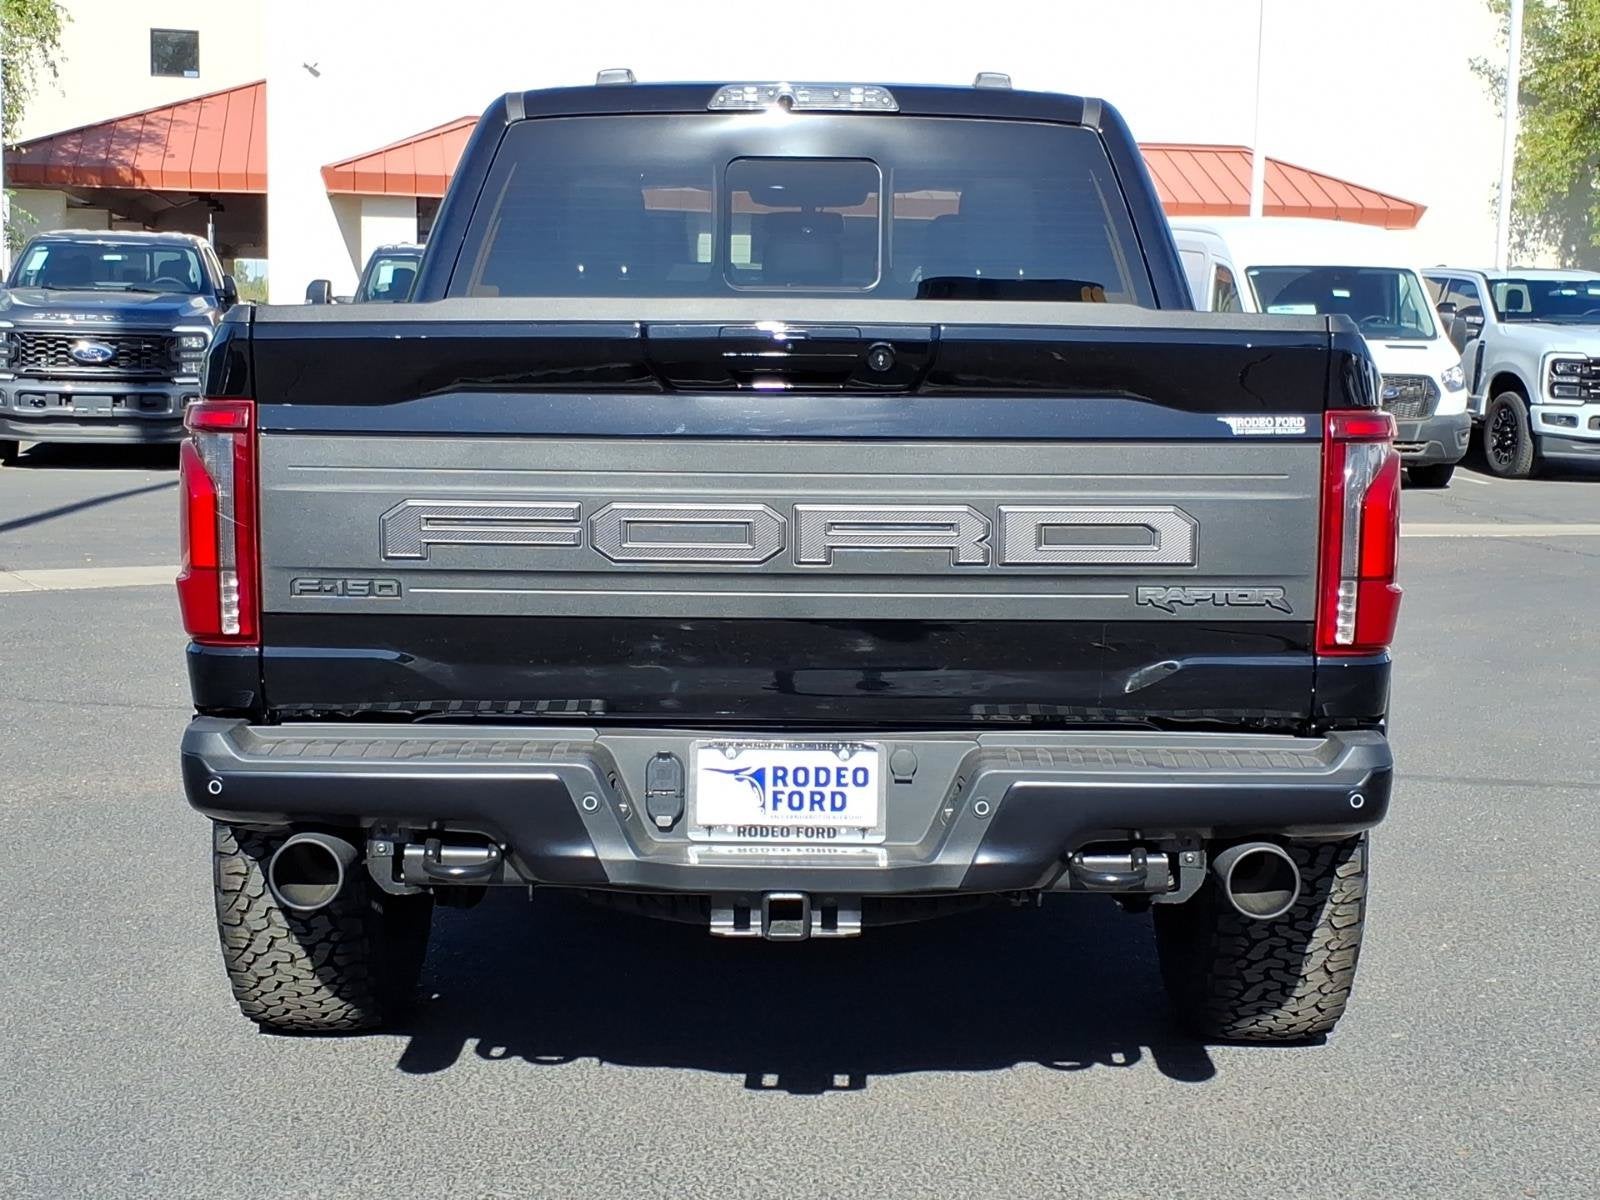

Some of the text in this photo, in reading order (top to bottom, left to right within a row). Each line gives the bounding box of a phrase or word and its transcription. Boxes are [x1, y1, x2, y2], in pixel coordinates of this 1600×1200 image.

[1236, 417, 1305, 427] RODEO FORD
[380, 498, 1200, 567] FORD
[290, 577, 402, 599] F-150
[1136, 585, 1293, 615] RAPTOR
[772, 766, 869, 787] RODEO
[772, 790, 847, 812] FORD
[737, 826, 837, 839] RODEO FORD
